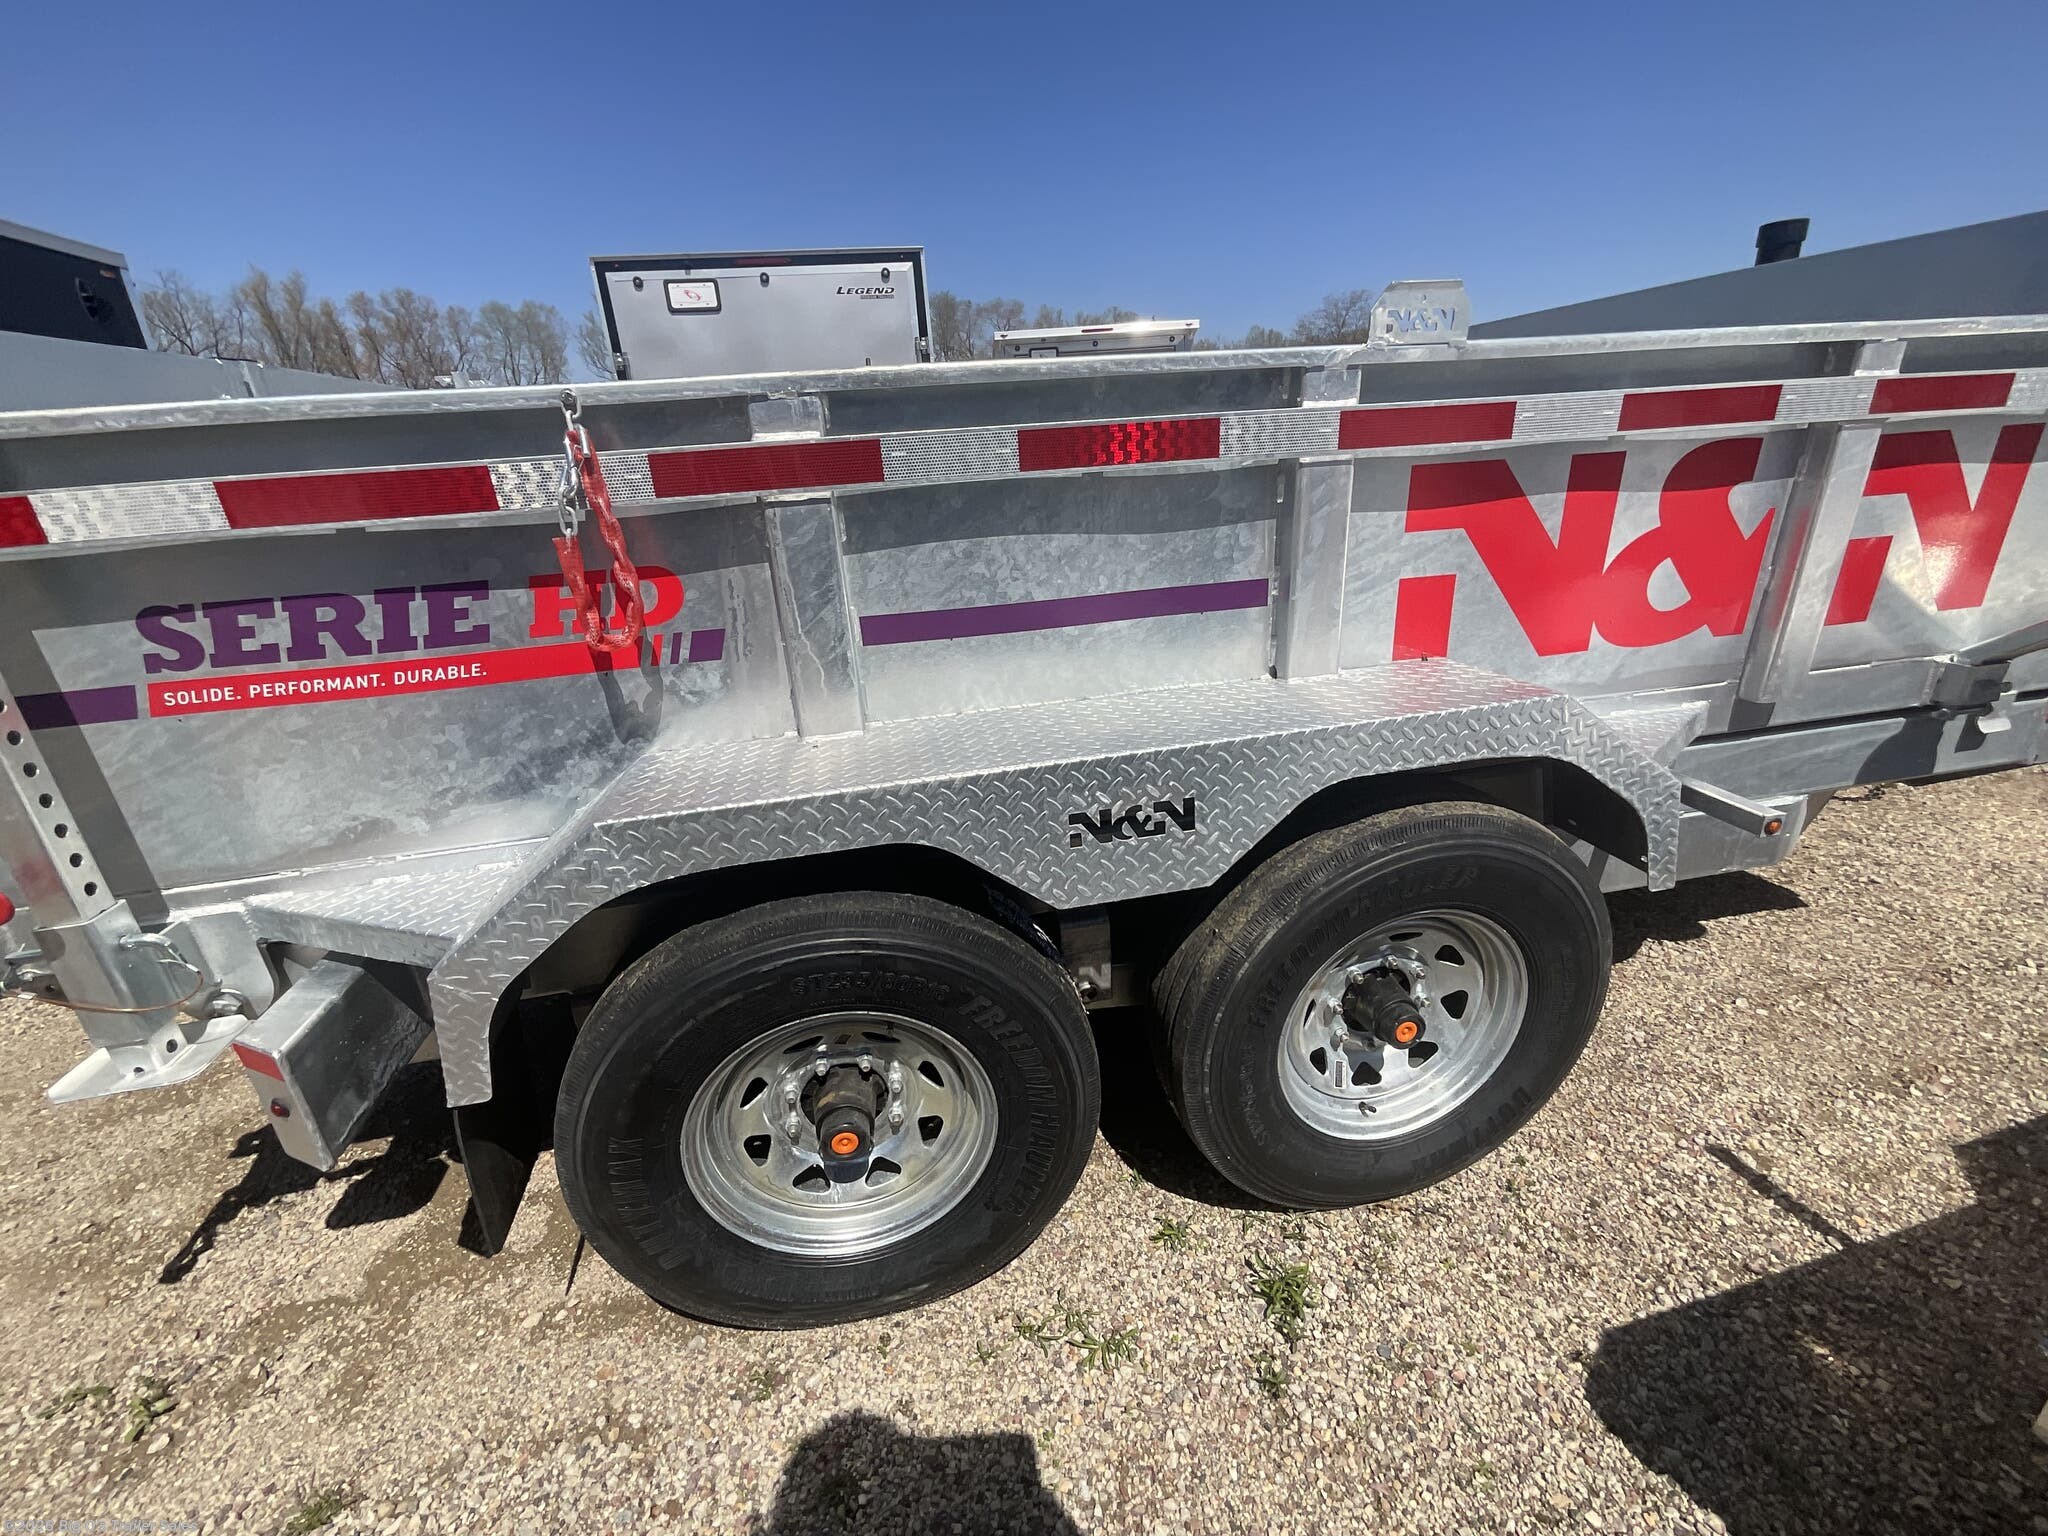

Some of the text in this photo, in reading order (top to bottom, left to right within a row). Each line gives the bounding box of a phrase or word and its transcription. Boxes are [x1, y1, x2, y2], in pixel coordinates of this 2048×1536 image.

[836, 286, 895, 295] LEGEND
[1392, 422, 2046, 661] N&N
[135, 565, 685, 674] SERIE HD
[163, 663, 488, 707] SOLIDE. PERFORMANT. DURABLE.
[1068, 797, 1196, 849] N&N
